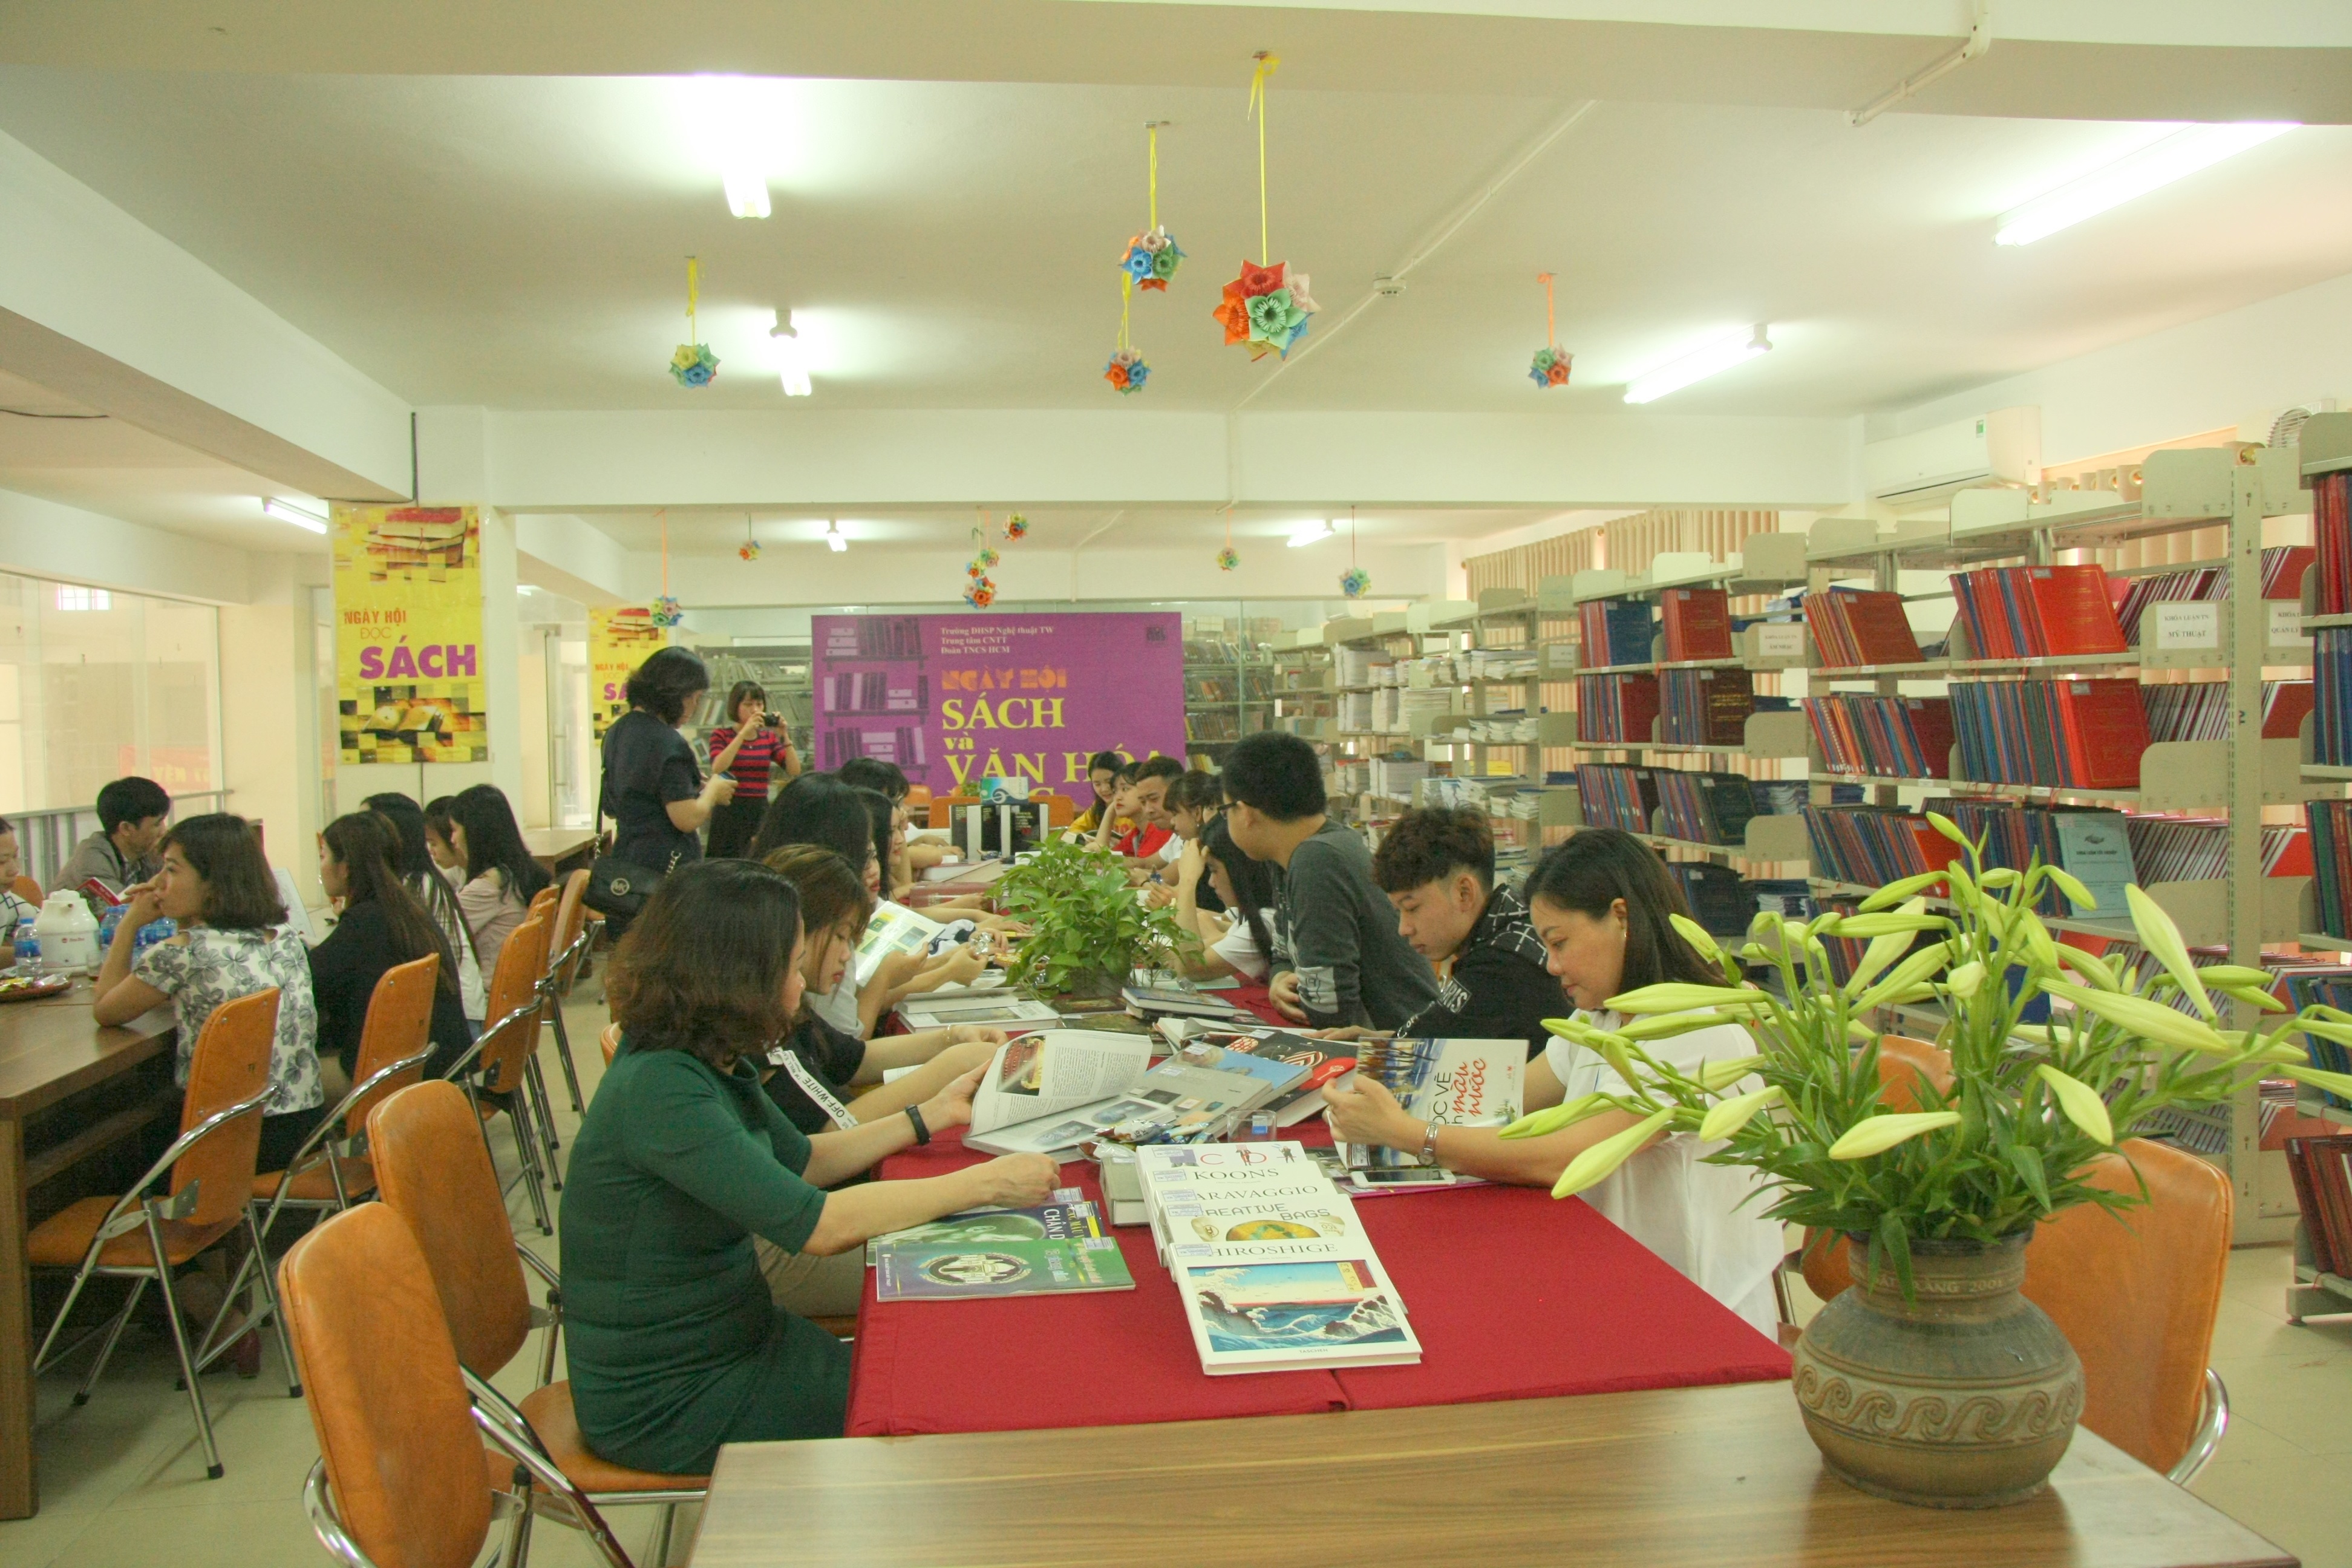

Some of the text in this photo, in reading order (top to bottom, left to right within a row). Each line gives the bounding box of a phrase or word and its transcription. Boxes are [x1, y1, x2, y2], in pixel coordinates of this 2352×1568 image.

[344, 607, 406, 626] NGÀY HỘI
[360, 627, 391, 641] ĐỌC
[996, 627, 1016, 635] Nghệ
[1018, 627, 1037, 635] thuật
[941, 637, 964, 645] Trung
[359, 635, 476, 680] SÁCH
[942, 665, 1067, 693] NGÀY HỘI
[941, 691, 1065, 730] SÁCH
[943, 732, 974, 750] và
[944, 748, 1046, 783] VĂN
[1434, 1073, 1451, 1096] VẼ
[1451, 1062, 1469, 1113] màu
[1468, 1058, 1486, 1117] nước
[802, 1077, 845, 1118] OFF-WHITE
[1194, 1168, 1279, 1180] KOONS
[1197, 1186, 1318, 1201] ARAVAGGIO
[1202, 1203, 1289, 1217] REATIVE
[1279, 1209, 1330, 1221] BAGS
[1044, 1209, 1067, 1232] CHÂN
[1209, 1244, 1339, 1258] HIROSHIGE
